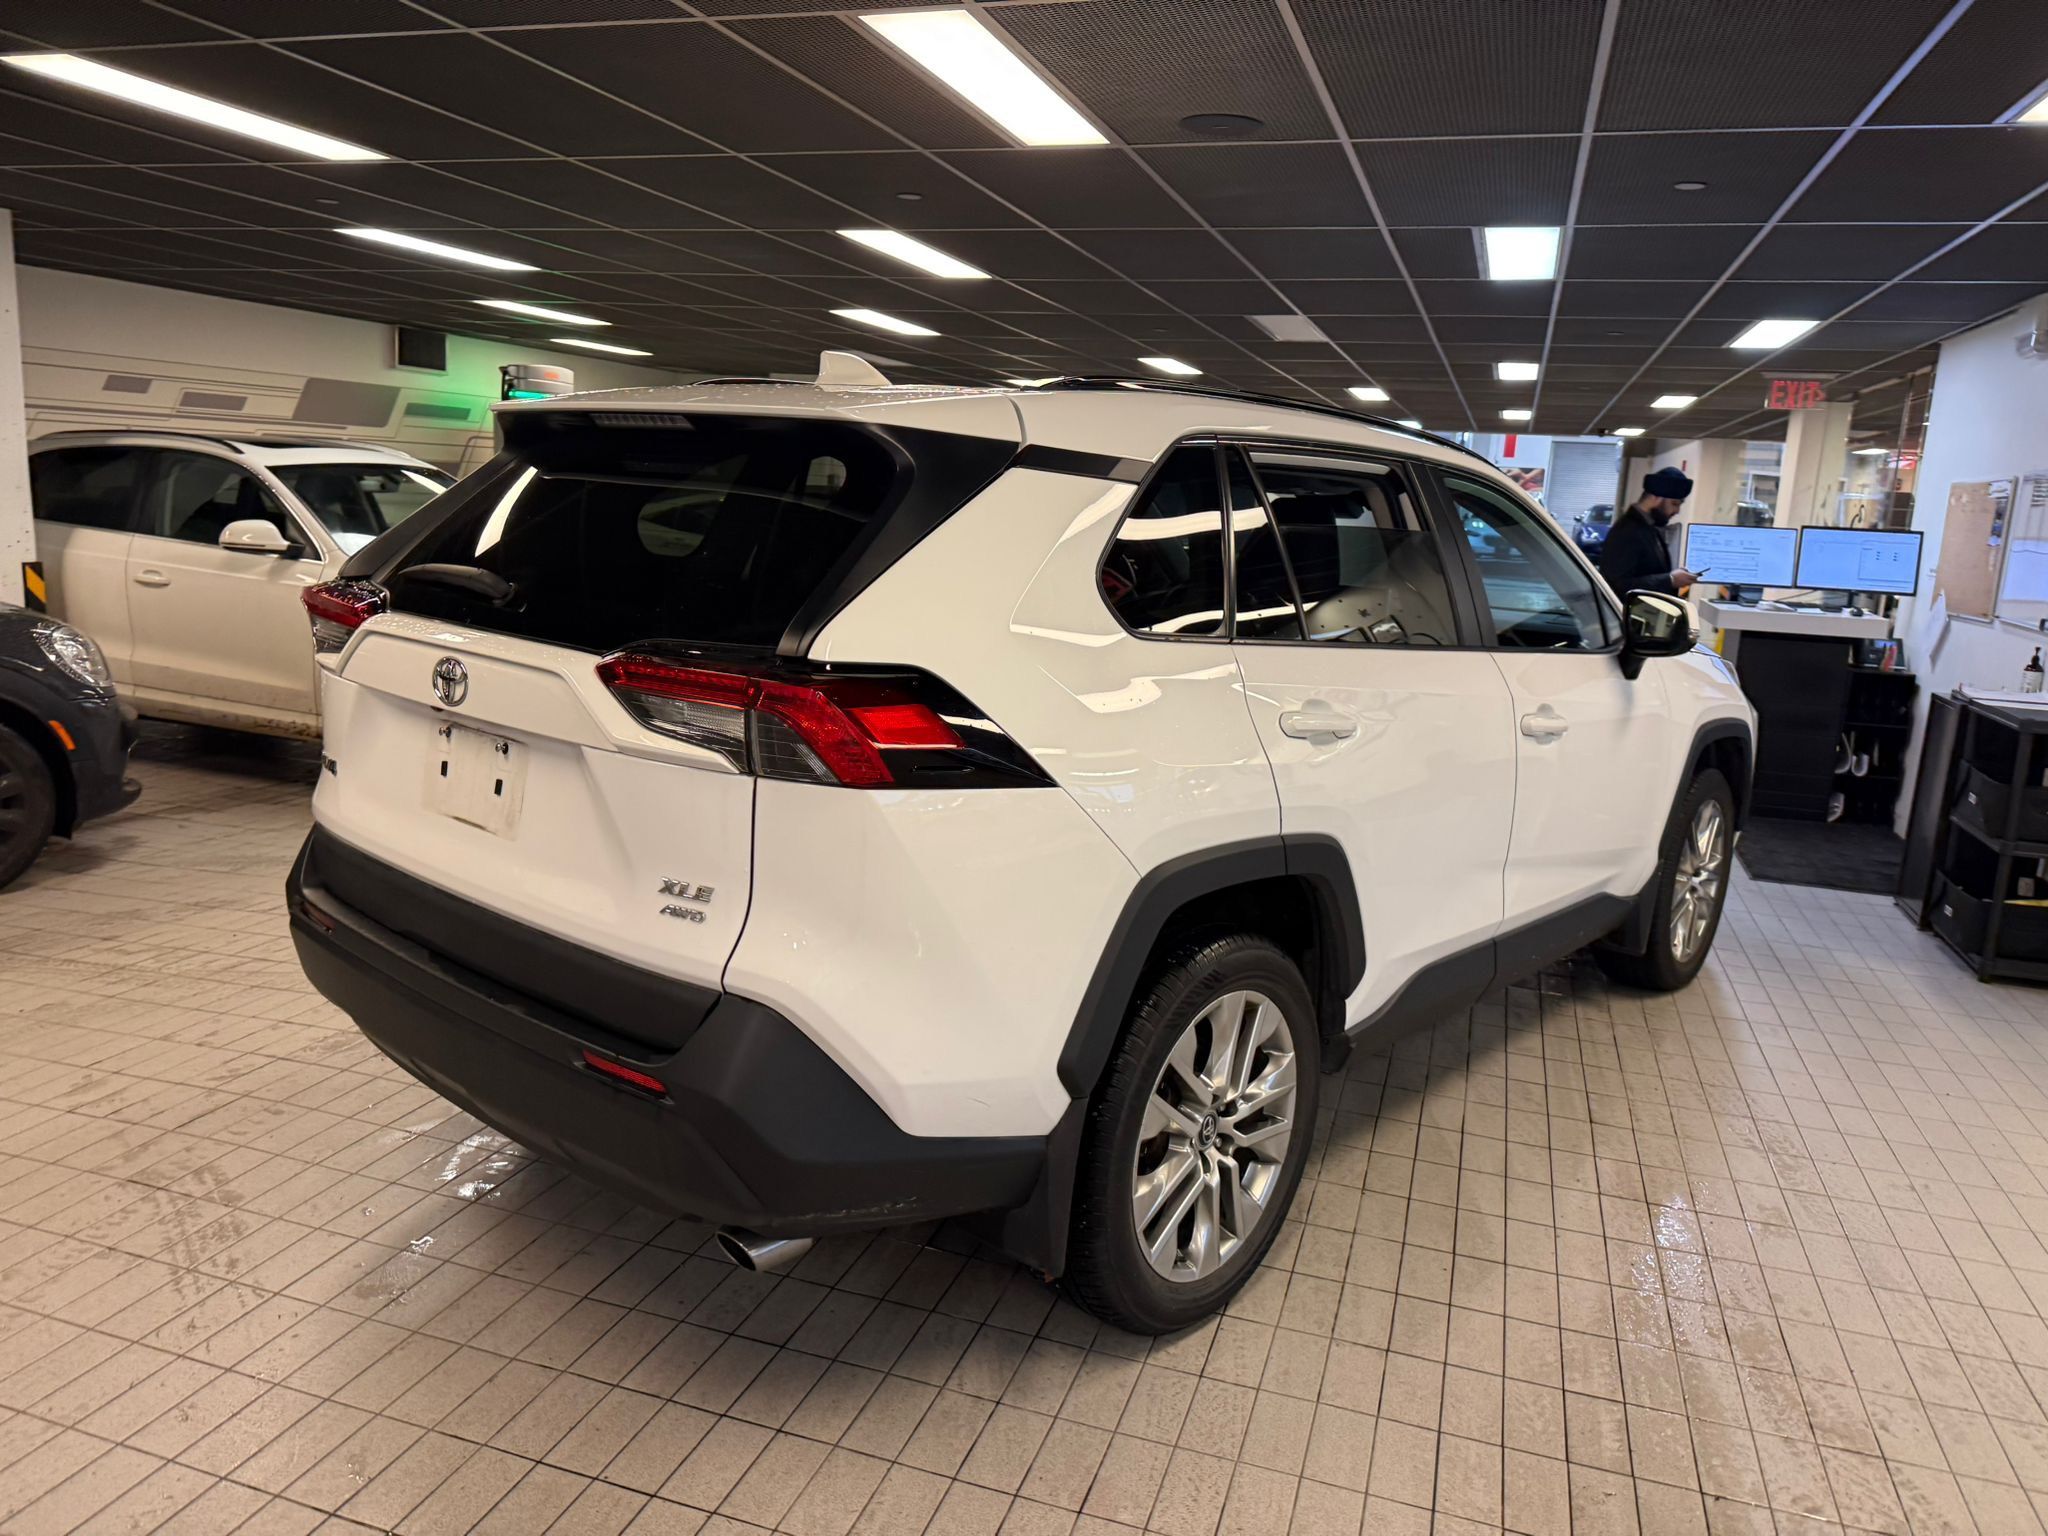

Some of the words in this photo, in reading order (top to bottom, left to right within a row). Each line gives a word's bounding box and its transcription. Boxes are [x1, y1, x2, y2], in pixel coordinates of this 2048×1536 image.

[1769, 380, 1821, 409] EXIT
[657, 876, 715, 903] XLE
[659, 904, 707, 924] AWD
